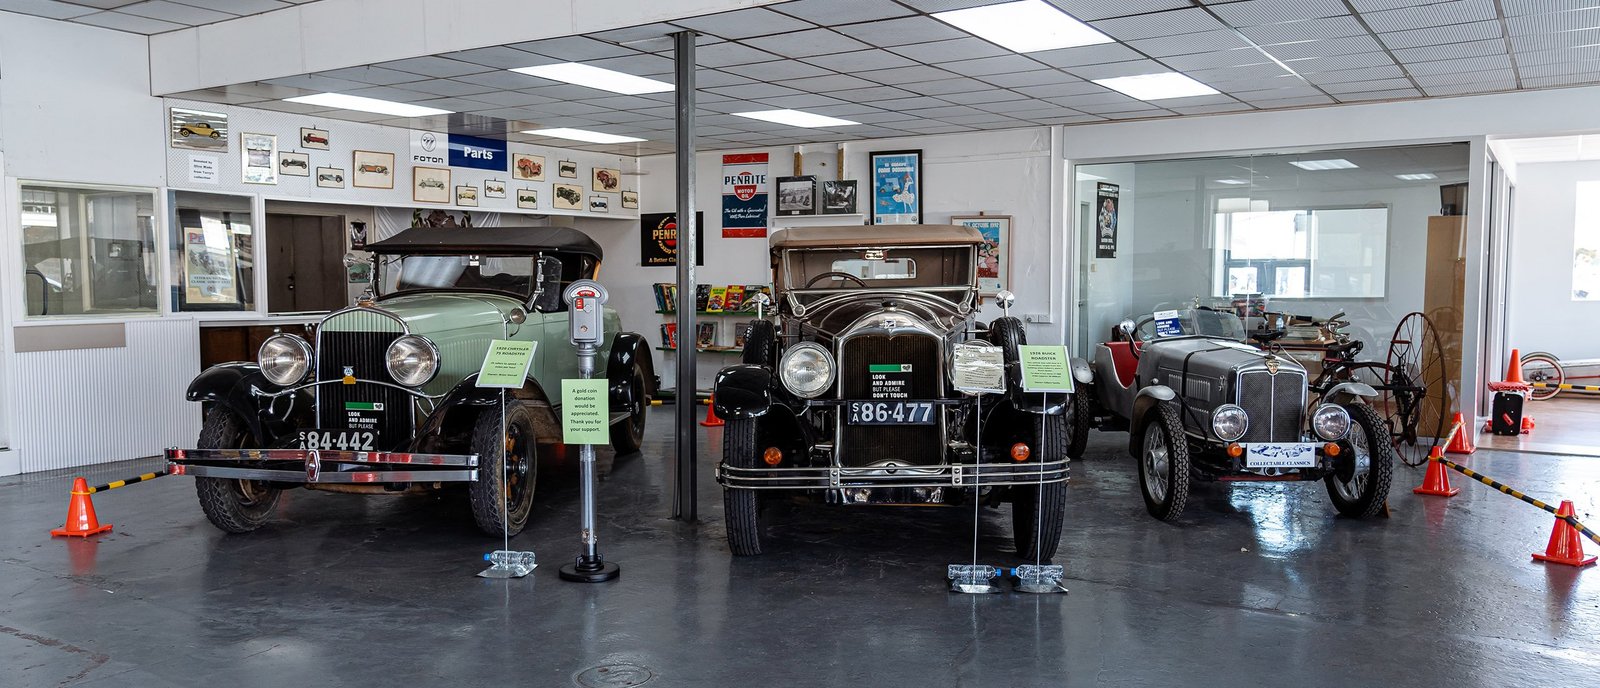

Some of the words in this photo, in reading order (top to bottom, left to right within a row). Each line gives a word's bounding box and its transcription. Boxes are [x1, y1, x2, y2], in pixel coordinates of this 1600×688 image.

[464, 146, 494, 160] Parts
[414, 155, 444, 164] FOTON
[724, 174, 766, 185] PENRITE
[653, 229, 676, 240] PENR
